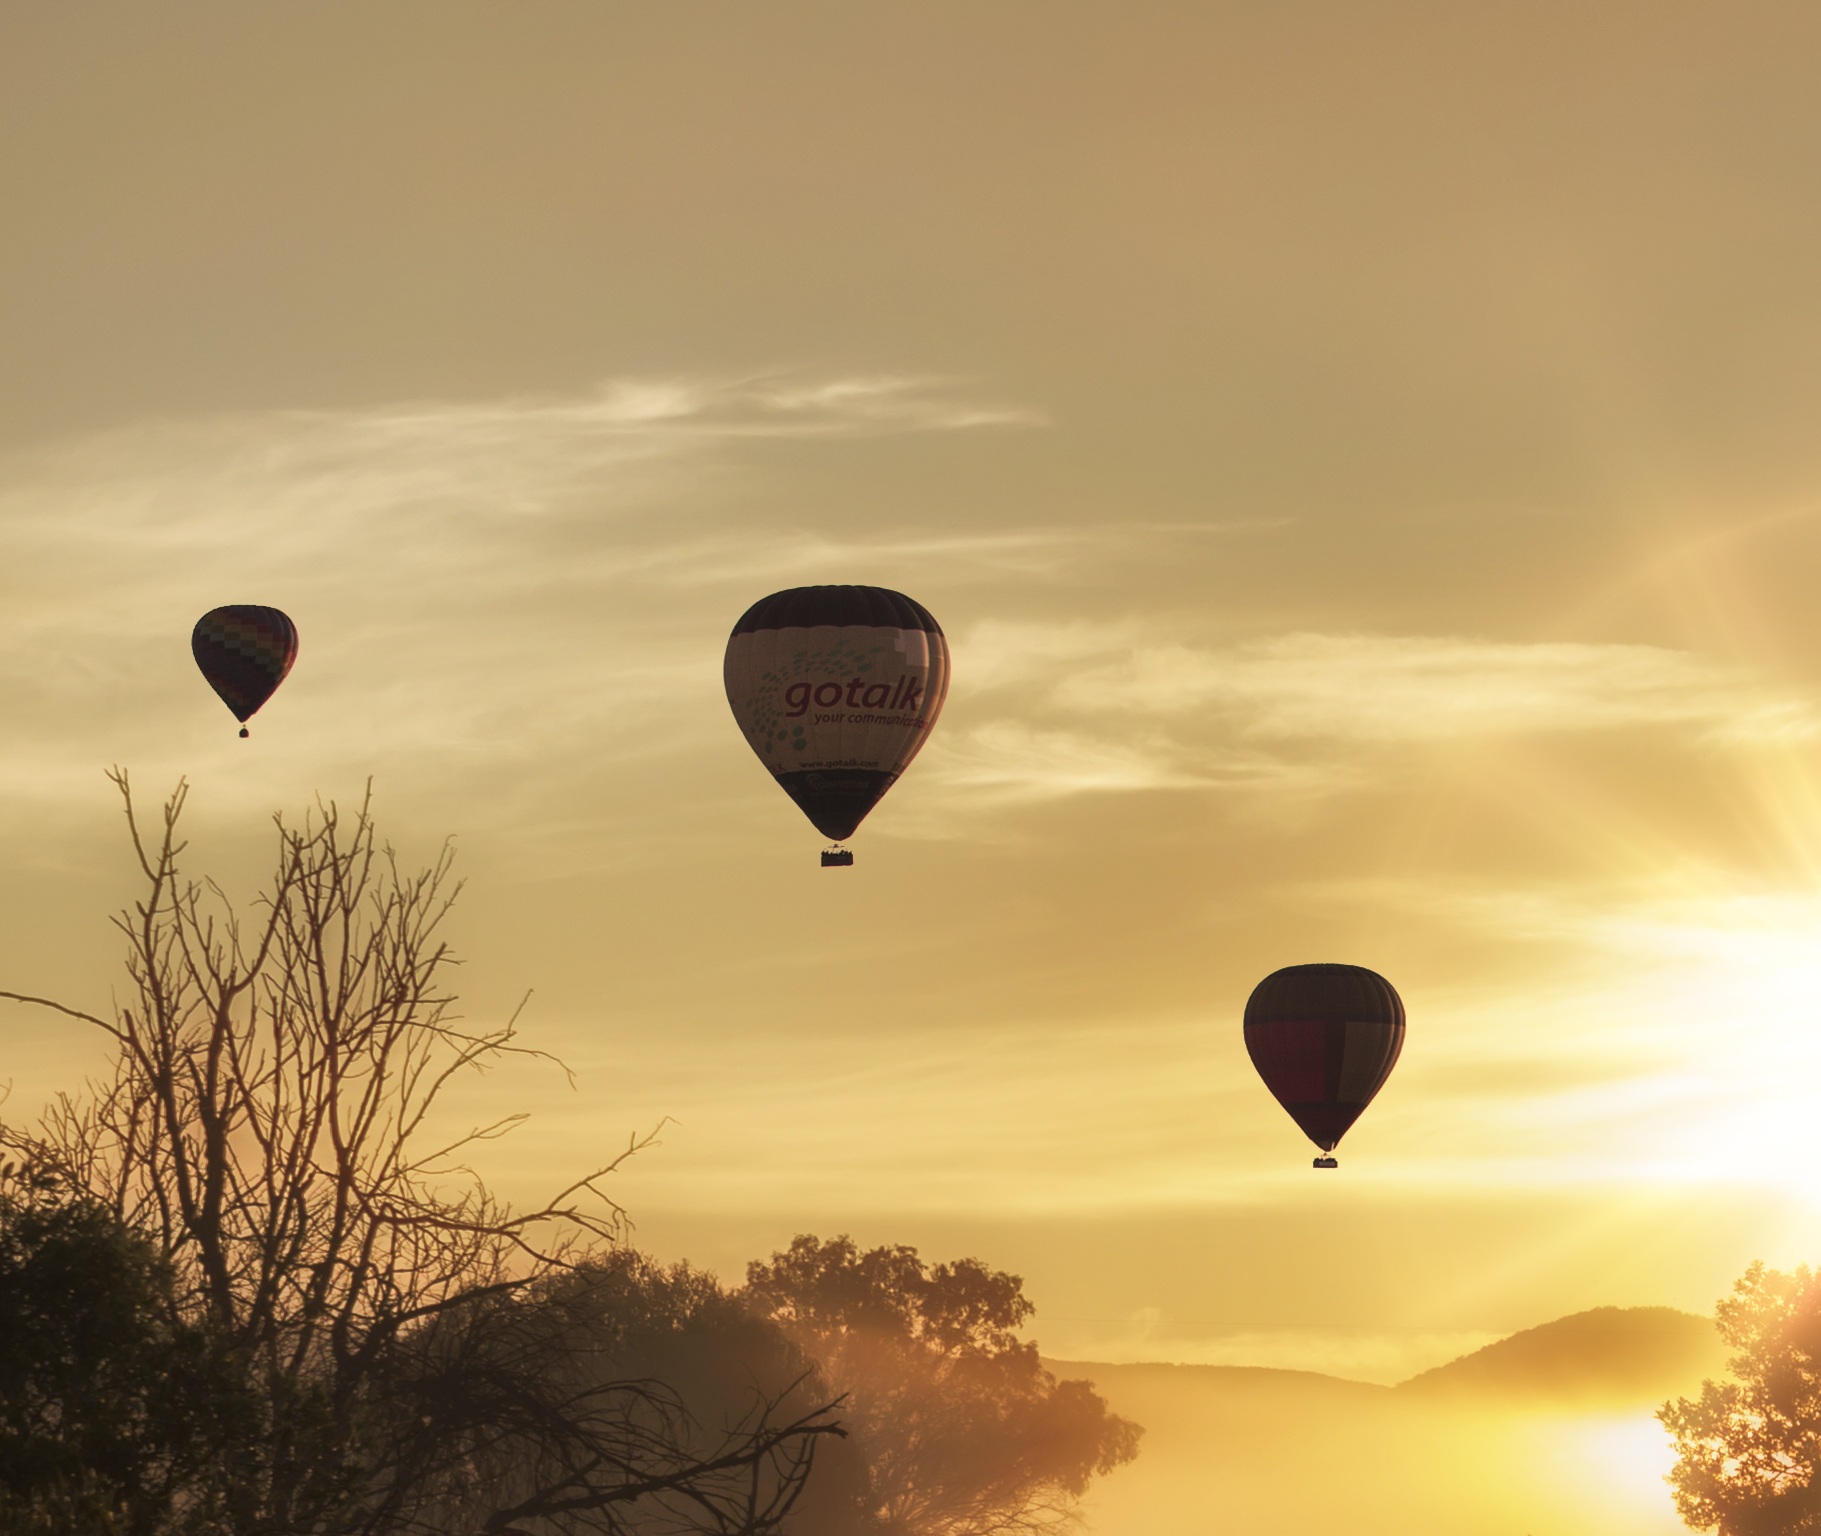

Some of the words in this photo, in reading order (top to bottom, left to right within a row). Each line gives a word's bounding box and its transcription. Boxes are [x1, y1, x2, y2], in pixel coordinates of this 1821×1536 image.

[785, 674, 924, 717] gotalk
[814, 713, 846, 725] your
[799, 759, 879, 768] www.gotalk.com
